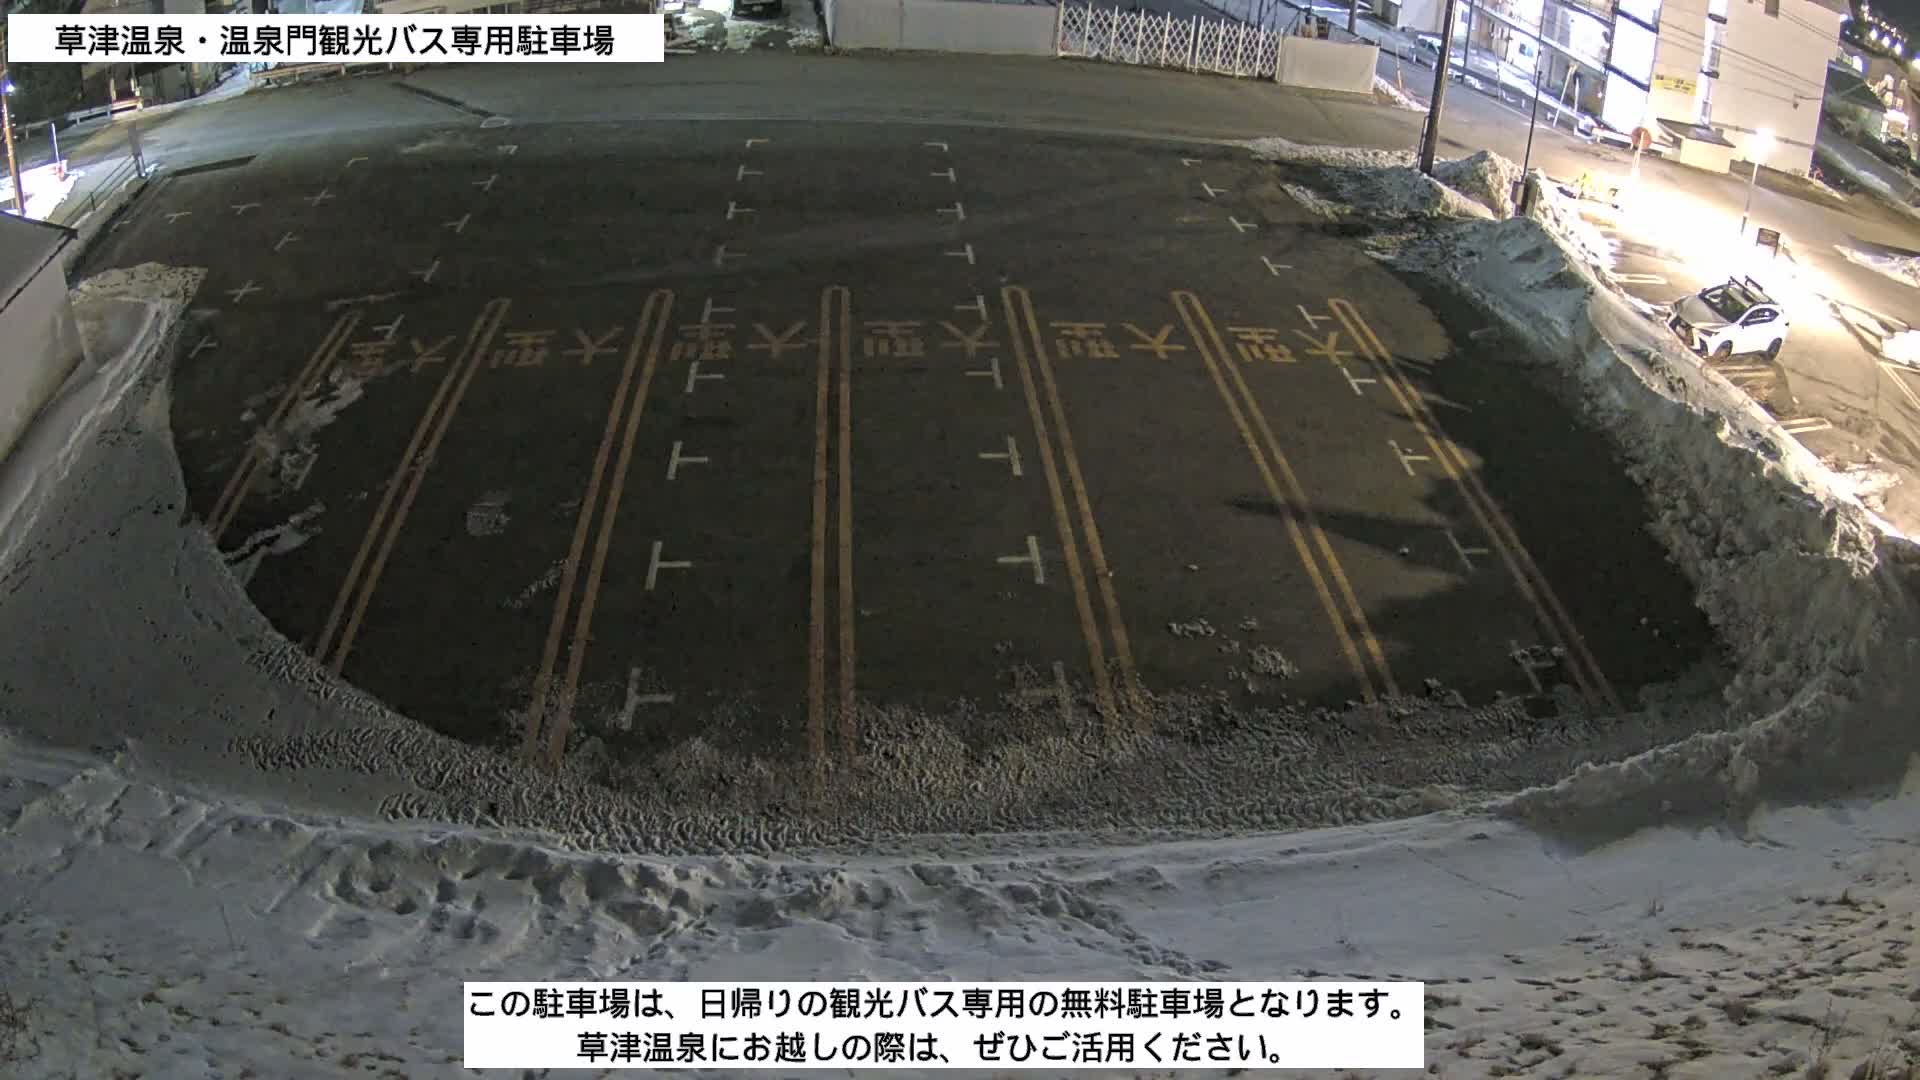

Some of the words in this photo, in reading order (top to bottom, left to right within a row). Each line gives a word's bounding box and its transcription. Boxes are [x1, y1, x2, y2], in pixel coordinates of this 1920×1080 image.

[862, 319, 1001, 359] 大型
[1049, 321, 1187, 361] 大型
[1227, 325, 1354, 364] 大型
